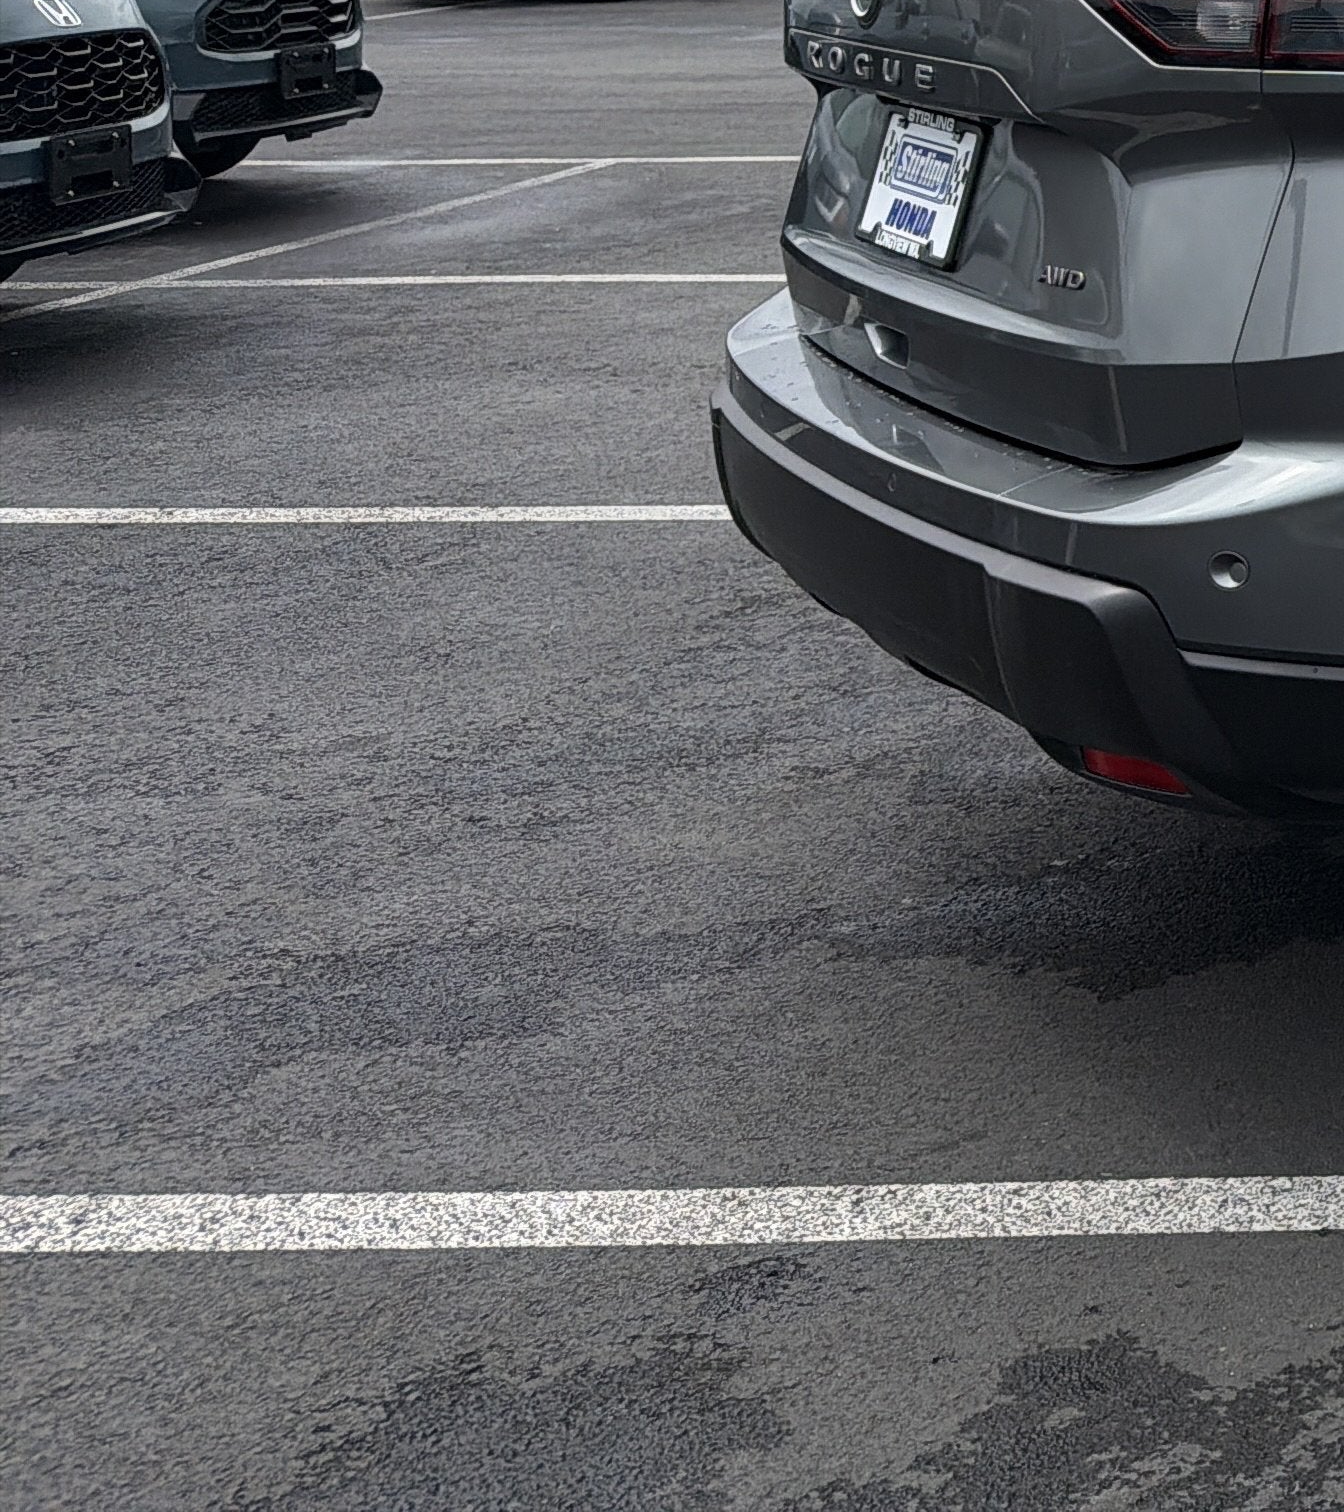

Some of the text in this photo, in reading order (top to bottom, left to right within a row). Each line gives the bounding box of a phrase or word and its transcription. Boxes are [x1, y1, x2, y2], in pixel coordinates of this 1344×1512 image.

[807, 40, 935, 90] ROGUE
[907, 108, 956, 131] STIRLING
[897, 144, 950, 188] Stirling
[885, 197, 938, 239] HONDA
[1039, 264, 1085, 289] AWD
